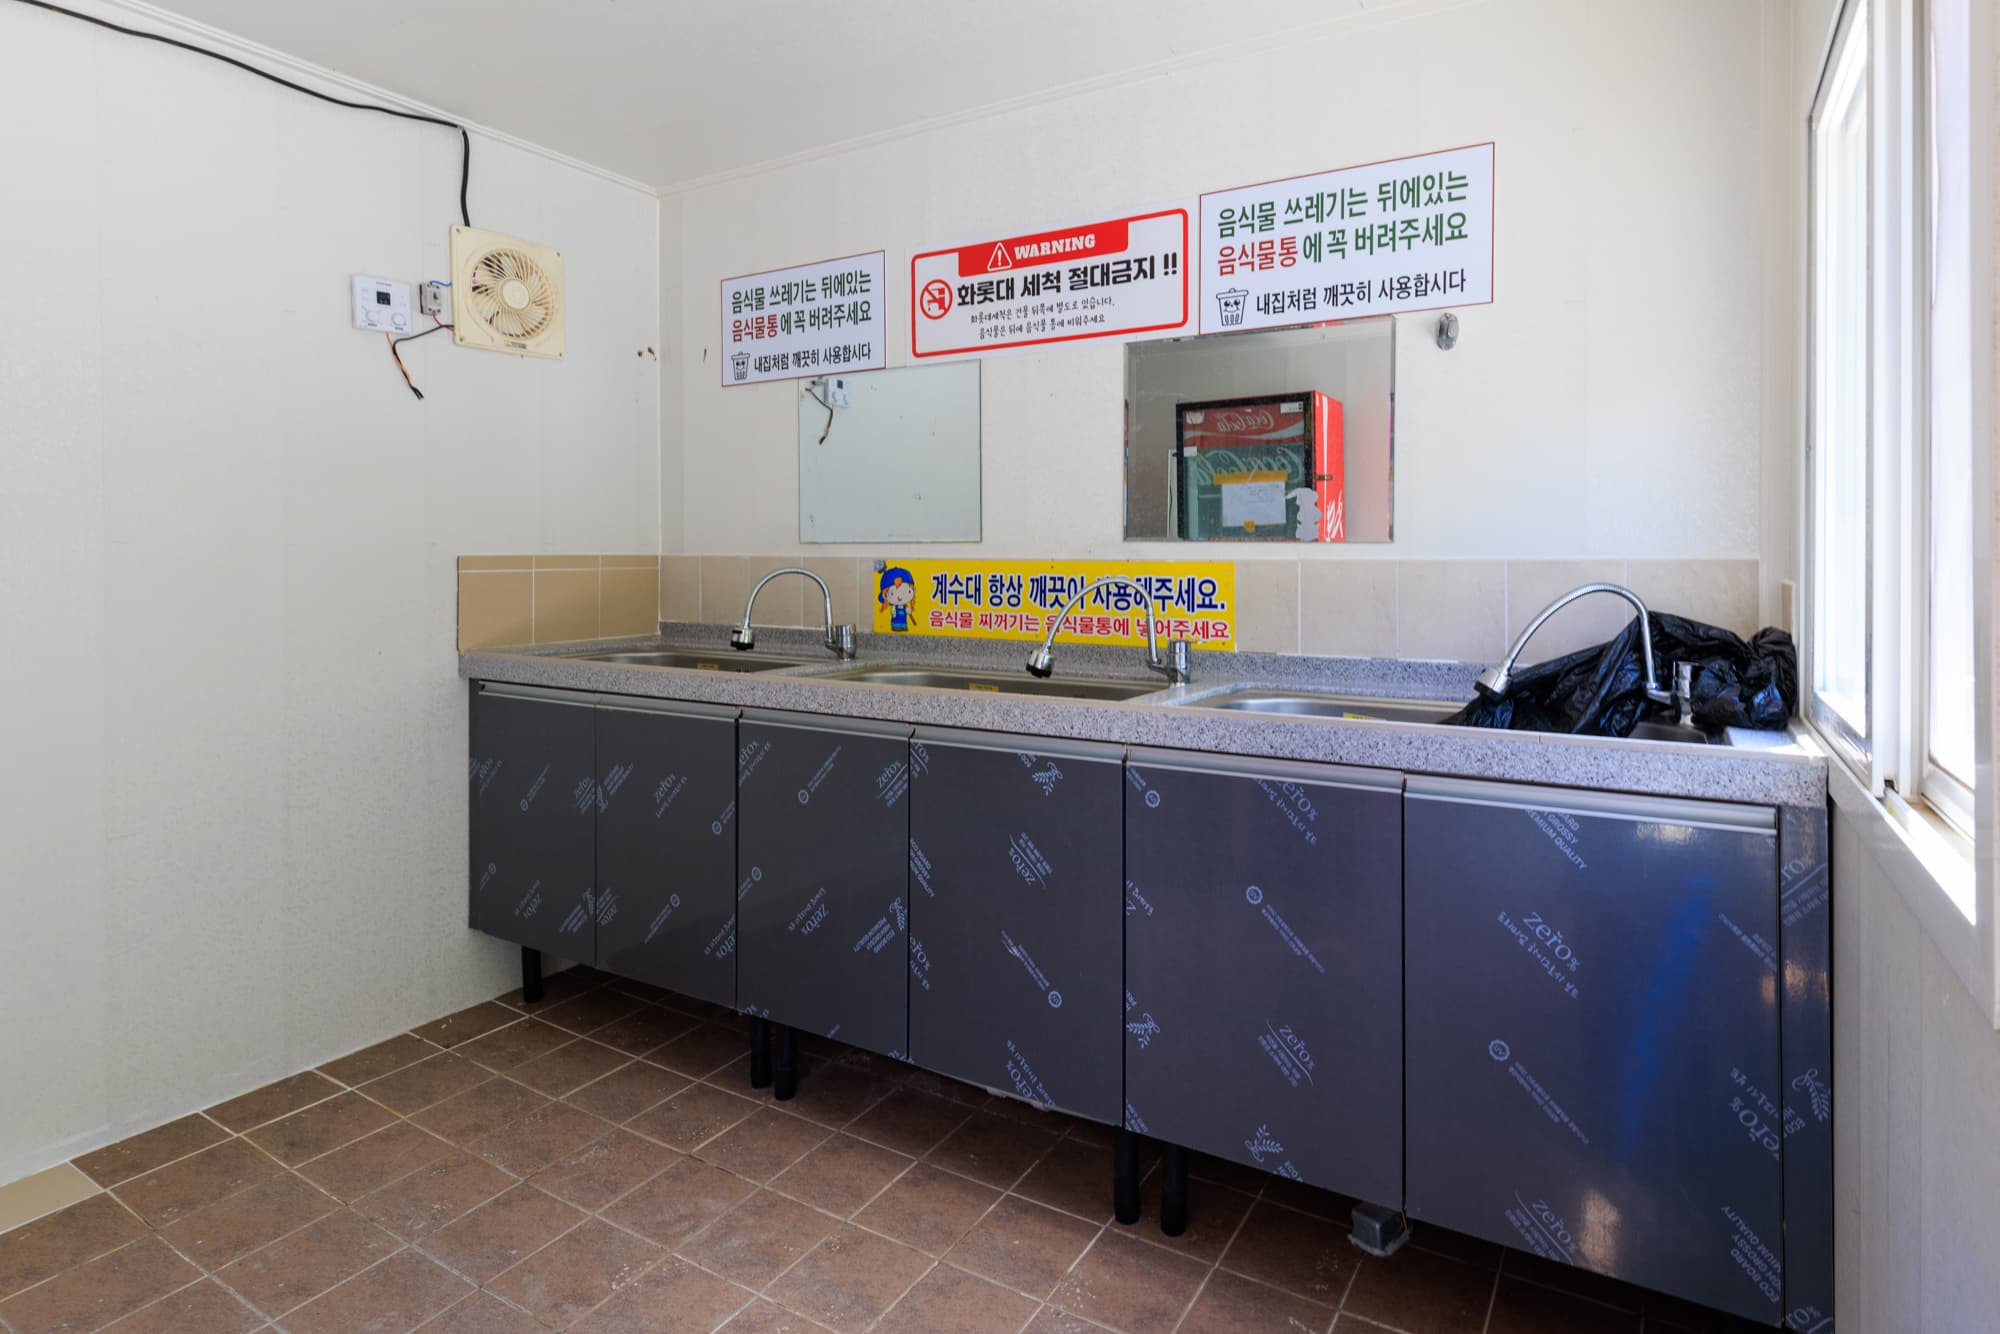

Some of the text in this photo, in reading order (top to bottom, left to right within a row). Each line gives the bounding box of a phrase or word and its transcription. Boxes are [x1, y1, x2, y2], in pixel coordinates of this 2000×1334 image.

[1217, 170, 1469, 239] 음식물 쓰레기는 뒤에있는
[1014, 233, 1096, 260] WARNING
[1326, 229, 1348, 260] 꼭
[1354, 211, 1468, 256] 버려주세요
[732, 270, 872, 314] 음식물 쓰레기는 뒤에있는
[957, 277, 1015, 307] 화롯대
[1020, 269, 1062, 298] 세척
[1068, 255, 1155, 292] 절대금지
[1256, 268, 1467, 315] 내집처럼 깨끗히 사용합시다
[794, 309, 806, 334] 꼭
[809, 300, 872, 331] 버려주세요
[754, 352, 789, 373] 내집처럼
[822, 341, 872, 365] 사용합시다
[931, 573, 982, 607] 계수대
[988, 574, 1023, 608] 항상
[1029, 575, 1085, 610] 깨끗이
[930, 610, 973, 629] 음식물
[979, 612, 1040, 632] 찌꺼기는
